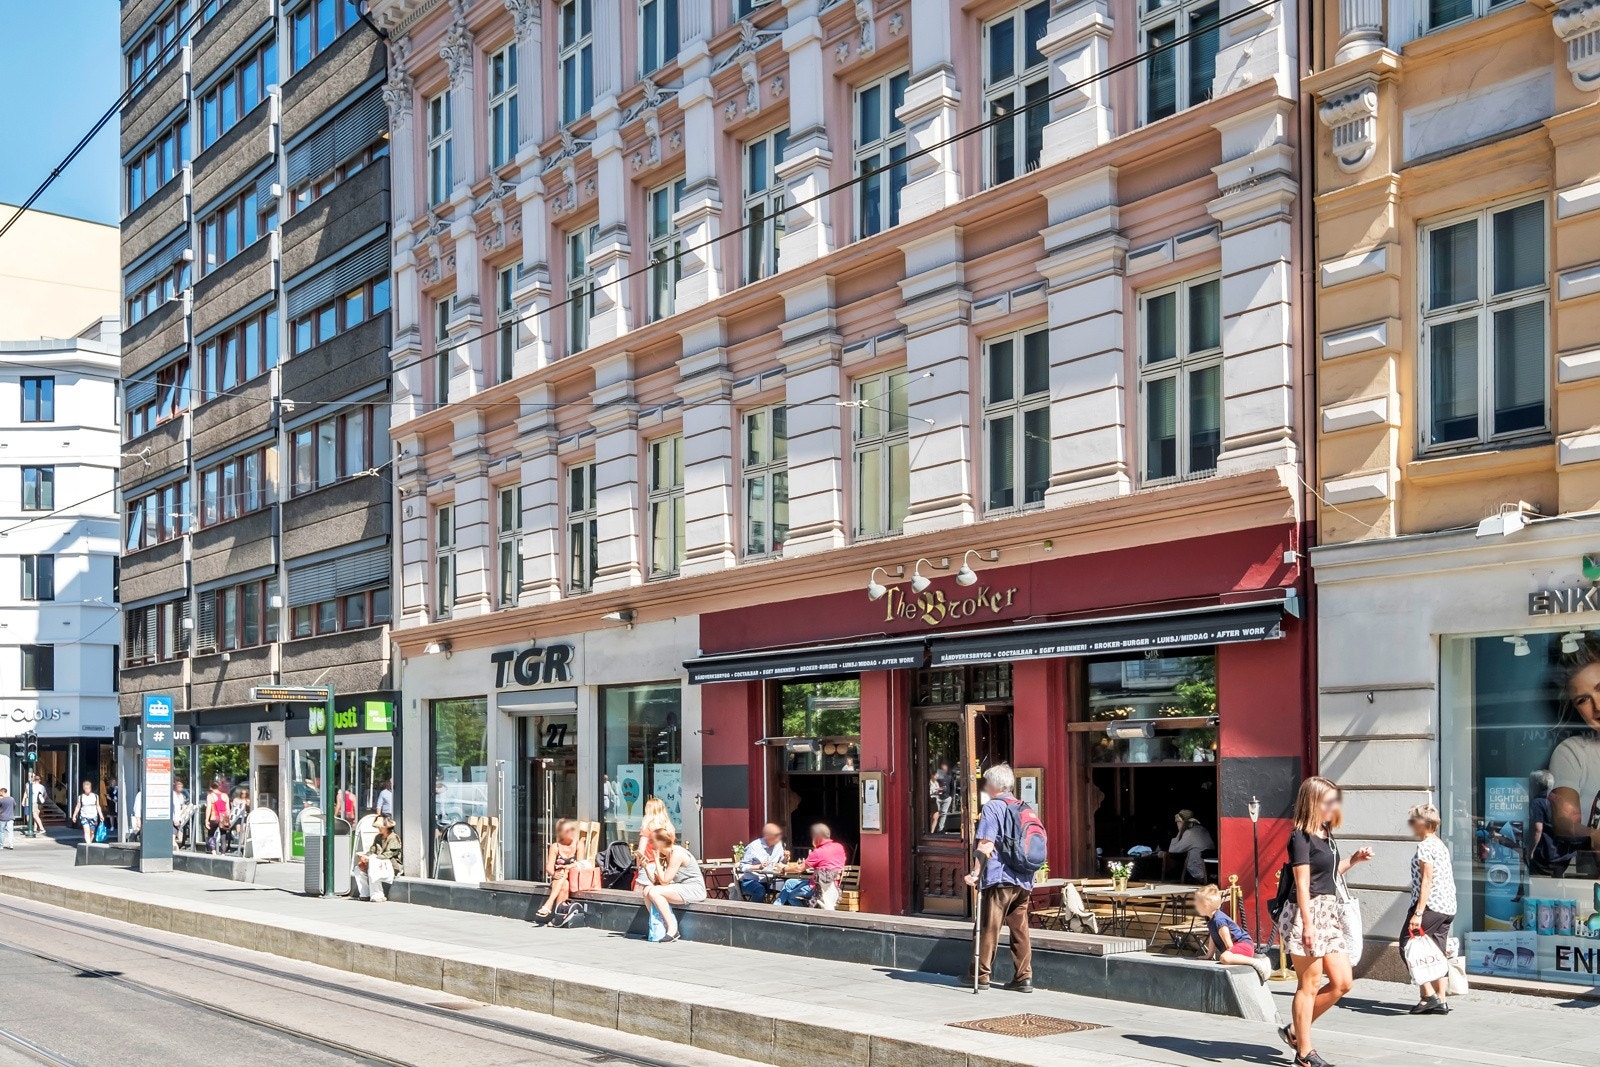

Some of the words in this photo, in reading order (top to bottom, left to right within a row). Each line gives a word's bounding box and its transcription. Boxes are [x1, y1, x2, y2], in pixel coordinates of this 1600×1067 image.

[884, 586, 917, 621] The
[917, 586, 1017, 625] Broker
[1528, 586, 1600, 616] ENK
[997, 648, 1033, 658] COCTAILBAR
[1039, 646, 1055, 654] EGET
[1056, 644, 1088, 653] BRENNERI
[1094, 638, 1150, 650] BROKER-BURGER
[1156, 632, 1209, 644] LUNSJ/MIDDAG
[1216, 629, 1240, 639] AFTER
[1242, 626, 1266, 636] WORK
[491, 644, 573, 688] TGR
[799, 662, 838, 672] BROKER-BURGER
[881, 657, 898, 665] AFTER
[898, 656, 915, 664] WORK
[546, 723, 568, 748] 27
[1489, 787, 1506, 795] GET
[1508, 787, 1521, 795] THE
[1489, 802, 1523, 810] FEELING
[1555, 945, 1600, 975] EN
